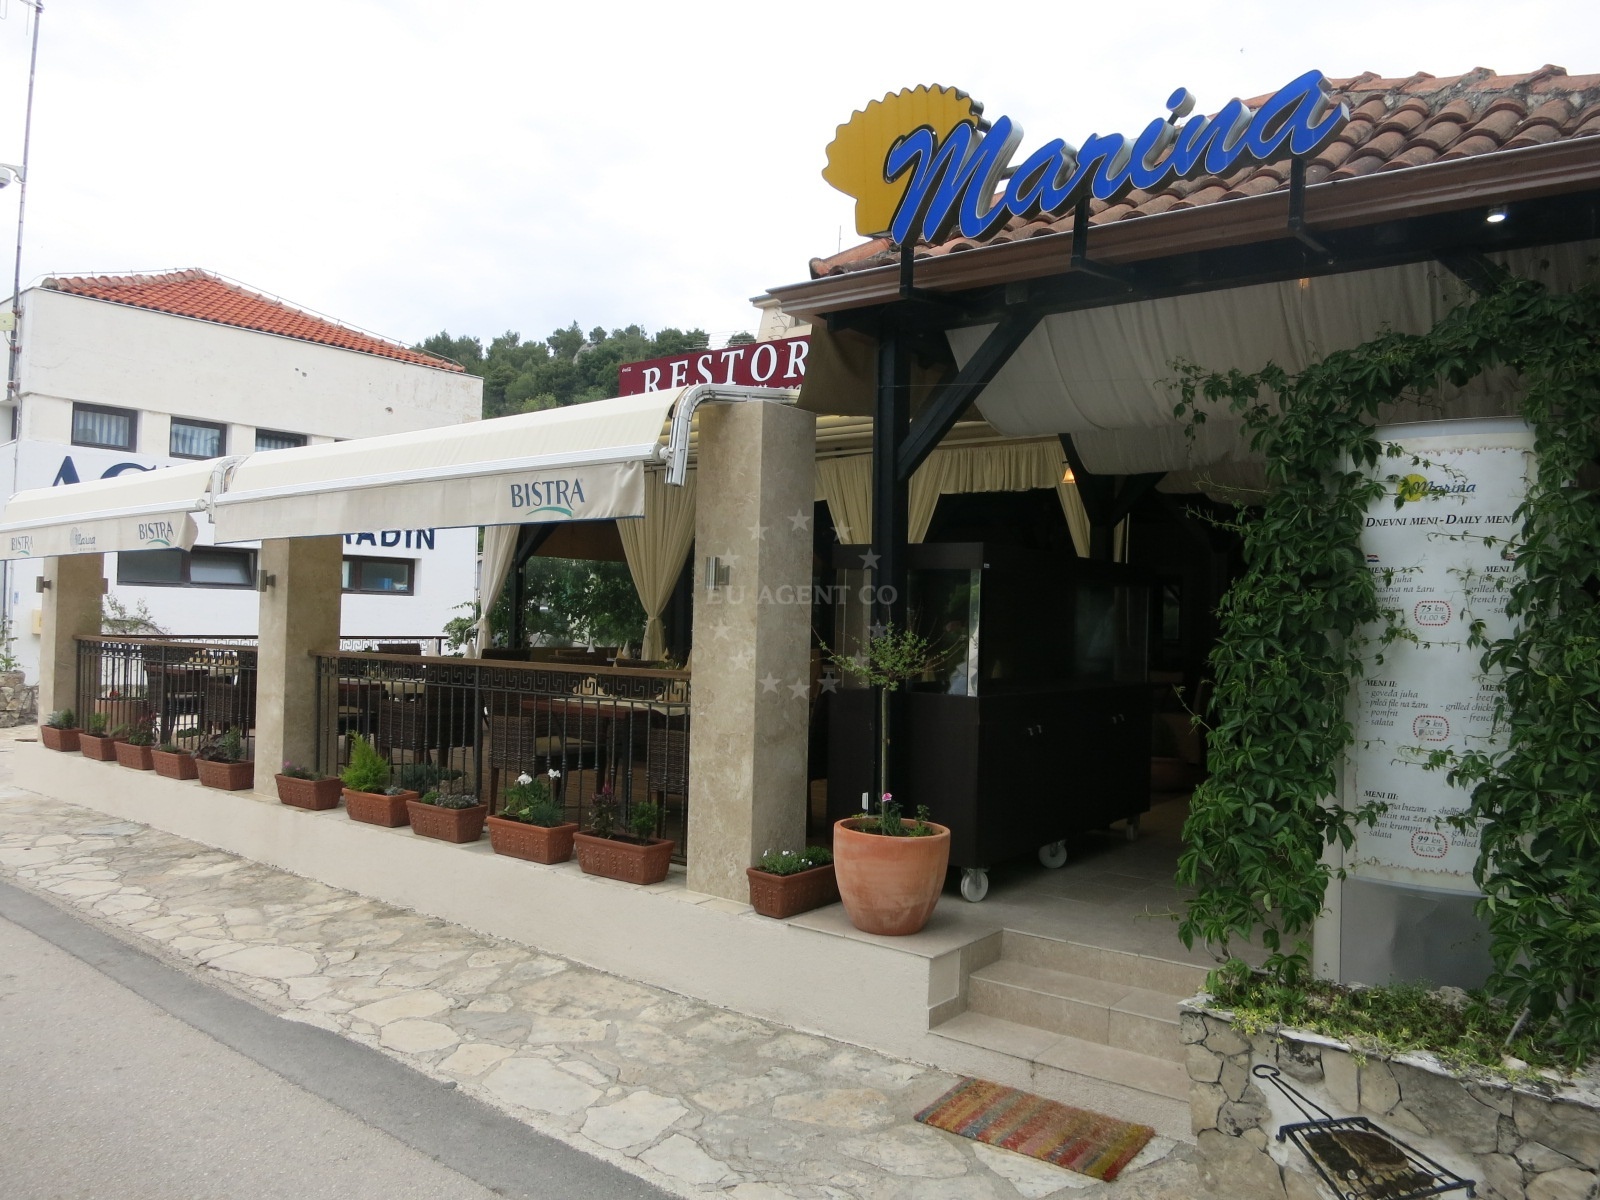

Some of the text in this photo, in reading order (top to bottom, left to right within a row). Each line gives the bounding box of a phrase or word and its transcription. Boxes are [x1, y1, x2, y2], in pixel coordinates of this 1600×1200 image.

[885, 69, 1350, 246] Marina
[510, 478, 585, 510] BISTRA
[1365, 517, 1407, 528] DNEVNI
[138, 521, 174, 542] BISTRA
[11, 535, 34, 551] BISTRA
[1367, 566, 1389, 574] MEN
[1484, 565, 1511, 573] MENI
[1375, 594, 1400, 605] omfrit
[1470, 595, 1511, 605] french fri
[1421, 604, 1444, 613] 75 kn
[1480, 684, 1504, 692] MEN
[1400, 690, 1419, 699] juha
[1476, 692, 1495, 703] beef
[1445, 702, 1470, 712] grilled
[1471, 703, 1496, 712] chicke
[1370, 718, 1394, 727] salata
[1493, 722, 1512, 733] sala
[1363, 790, 1386, 799] MENI
[1369, 829, 1393, 839] salata
[1452, 829, 1479, 839] grlled
[1417, 835, 1442, 844] 99 kn
[1451, 838, 1477, 848] boiled
